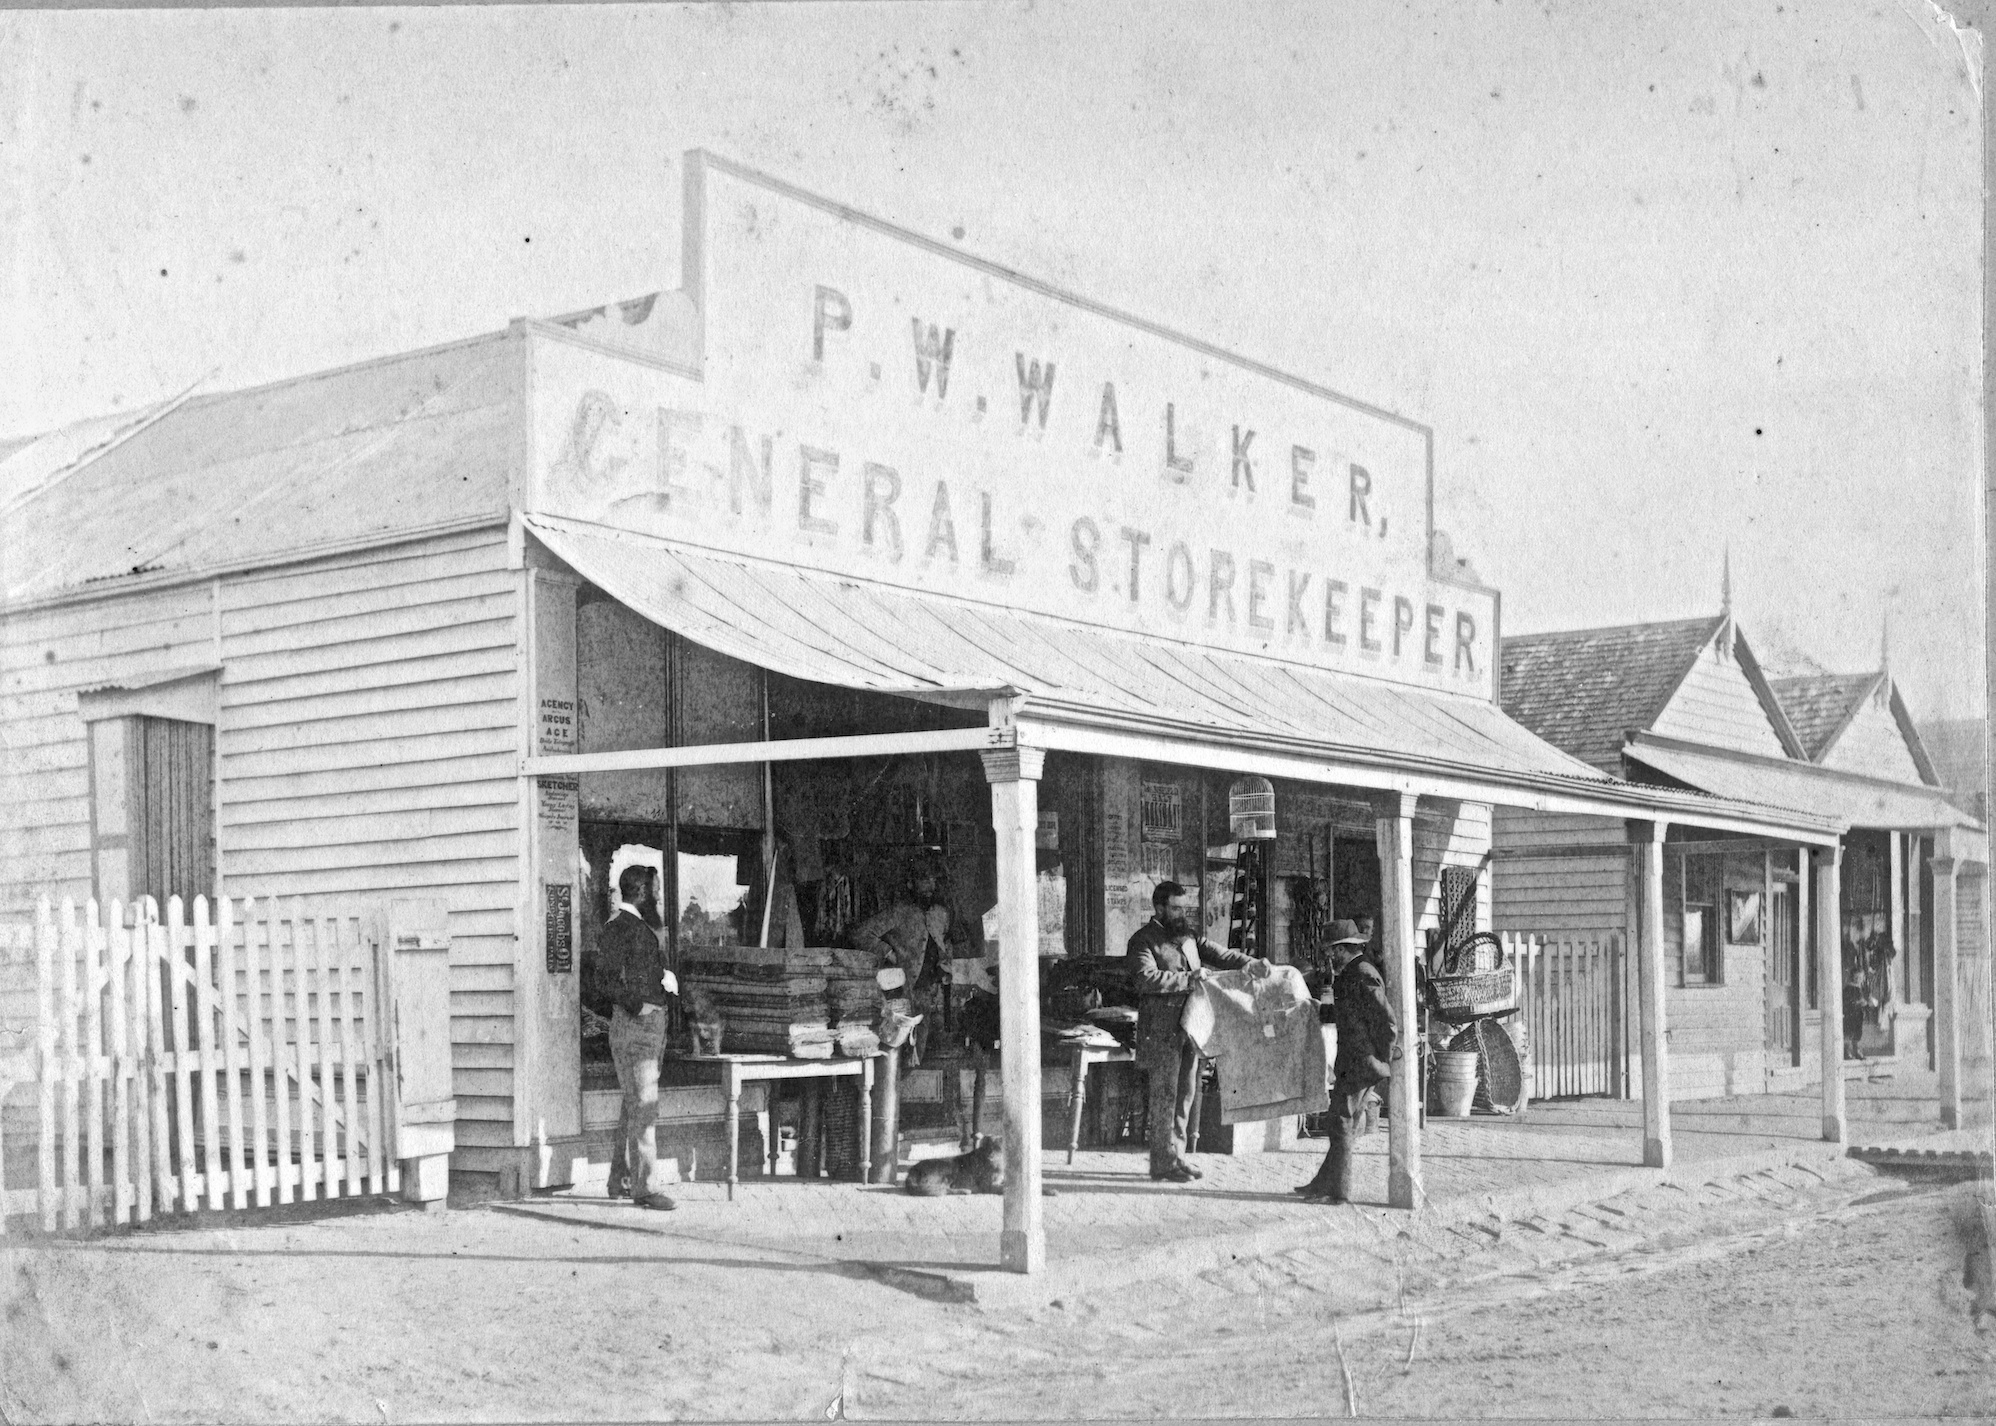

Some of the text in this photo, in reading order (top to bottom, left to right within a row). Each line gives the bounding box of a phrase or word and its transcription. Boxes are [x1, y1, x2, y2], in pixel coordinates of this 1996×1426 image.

[813, 284, 1388, 538] P. W. WALKER,
[571, 388, 1015, 574] GENERAL
[541, 699, 573, 711] AGENCY
[542, 714, 571, 725] ARGUS
[546, 727, 569, 738] AGE
[537, 780, 579, 791] SKETCHER
[556, 902, 571, 947] Jacobs
[556, 947, 571, 970] Oil
